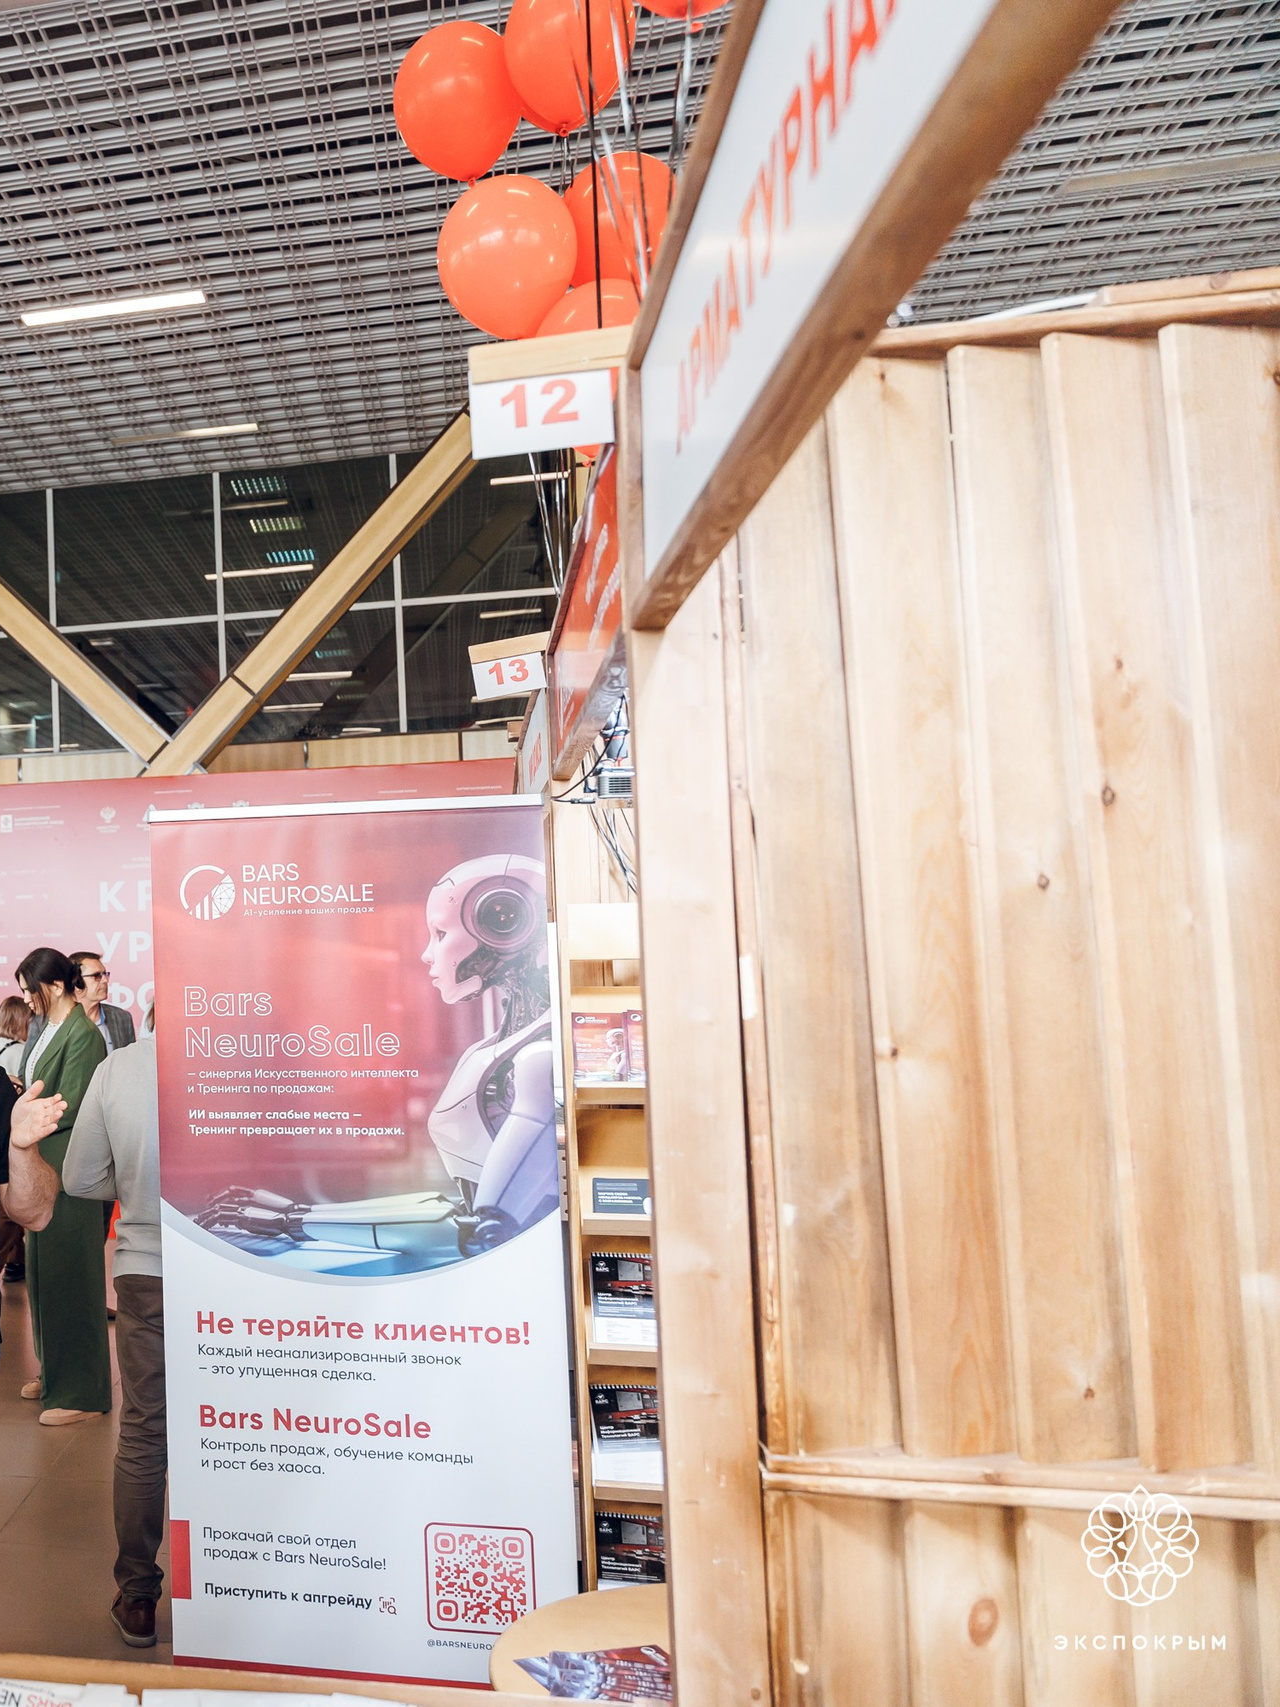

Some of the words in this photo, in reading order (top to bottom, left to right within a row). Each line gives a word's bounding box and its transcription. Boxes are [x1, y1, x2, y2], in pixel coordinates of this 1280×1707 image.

[676, 0, 898, 457] АРМАТУРНА
[500, 379, 579, 430] 12
[488, 659, 530, 686] 13
[242, 863, 299, 882] BARS
[243, 884, 374, 906] NEUROSALE
[305, 907, 335, 915] ваших
[337, 906, 375, 915] продаж
[184, 986, 273, 1017] Bars
[185, 1024, 400, 1058] NeuroSale
[199, 1070, 252, 1080] синергия
[254, 1069, 348, 1080] Искусственного
[350, 1069, 419, 1078] интеллекта
[187, 1085, 194, 1093] и
[197, 1084, 251, 1095] Тренинга
[253, 1085, 267, 1093] по
[270, 1085, 335, 1095] продажам:
[189, 1110, 206, 1119] ИИ
[208, 1111, 262, 1120] выявляет
[265, 1109, 311, 1120] слабые
[313, 1111, 350, 1120] места
[189, 1125, 237, 1136] Тренинг
[239, 1125, 316, 1136] превращает
[318, 1126, 333, 1135] их
[335, 1126, 343, 1135] в
[345, 1126, 405, 1136] продажи.
[196, 1311, 234, 1335] Не
[242, 1316, 364, 1342] теряйте
[374, 1322, 531, 1345] клиентов!
[197, 1343, 253, 1359] Каждый
[257, 1348, 407, 1364] неанализированный
[411, 1354, 462, 1366] звонок
[211, 1364, 234, 1375] это
[238, 1366, 318, 1379] упущенная
[322, 1368, 376, 1382] сделка.
[199, 1404, 264, 1430] Bars
[273, 1407, 432, 1439] NeuroSale
[200, 1437, 267, 1454] Контроль
[270, 1443, 330, 1458] продаж,
[333, 1446, 404, 1461] обучение
[408, 1451, 474, 1464] команды
[201, 1458, 209, 1468] и
[213, 1459, 246, 1471] рост
[250, 1458, 274, 1472] без
[277, 1463, 325, 1475] хаоса.
[203, 1526, 274, 1543] Прокачай
[277, 1531, 311, 1546] свой
[315, 1537, 357, 1549] отдел
[203, 1548, 258, 1561] продаж
[262, 1552, 271, 1561] с
[275, 1550, 305, 1564] Bars
[309, 1553, 387, 1570] NeuroSale!
[204, 1582, 287, 1601] Приступить
[291, 1592, 299, 1601] к
[303, 1593, 372, 1610] апгрейду
[427, 1639, 495, 1651] @BARSNEURO
